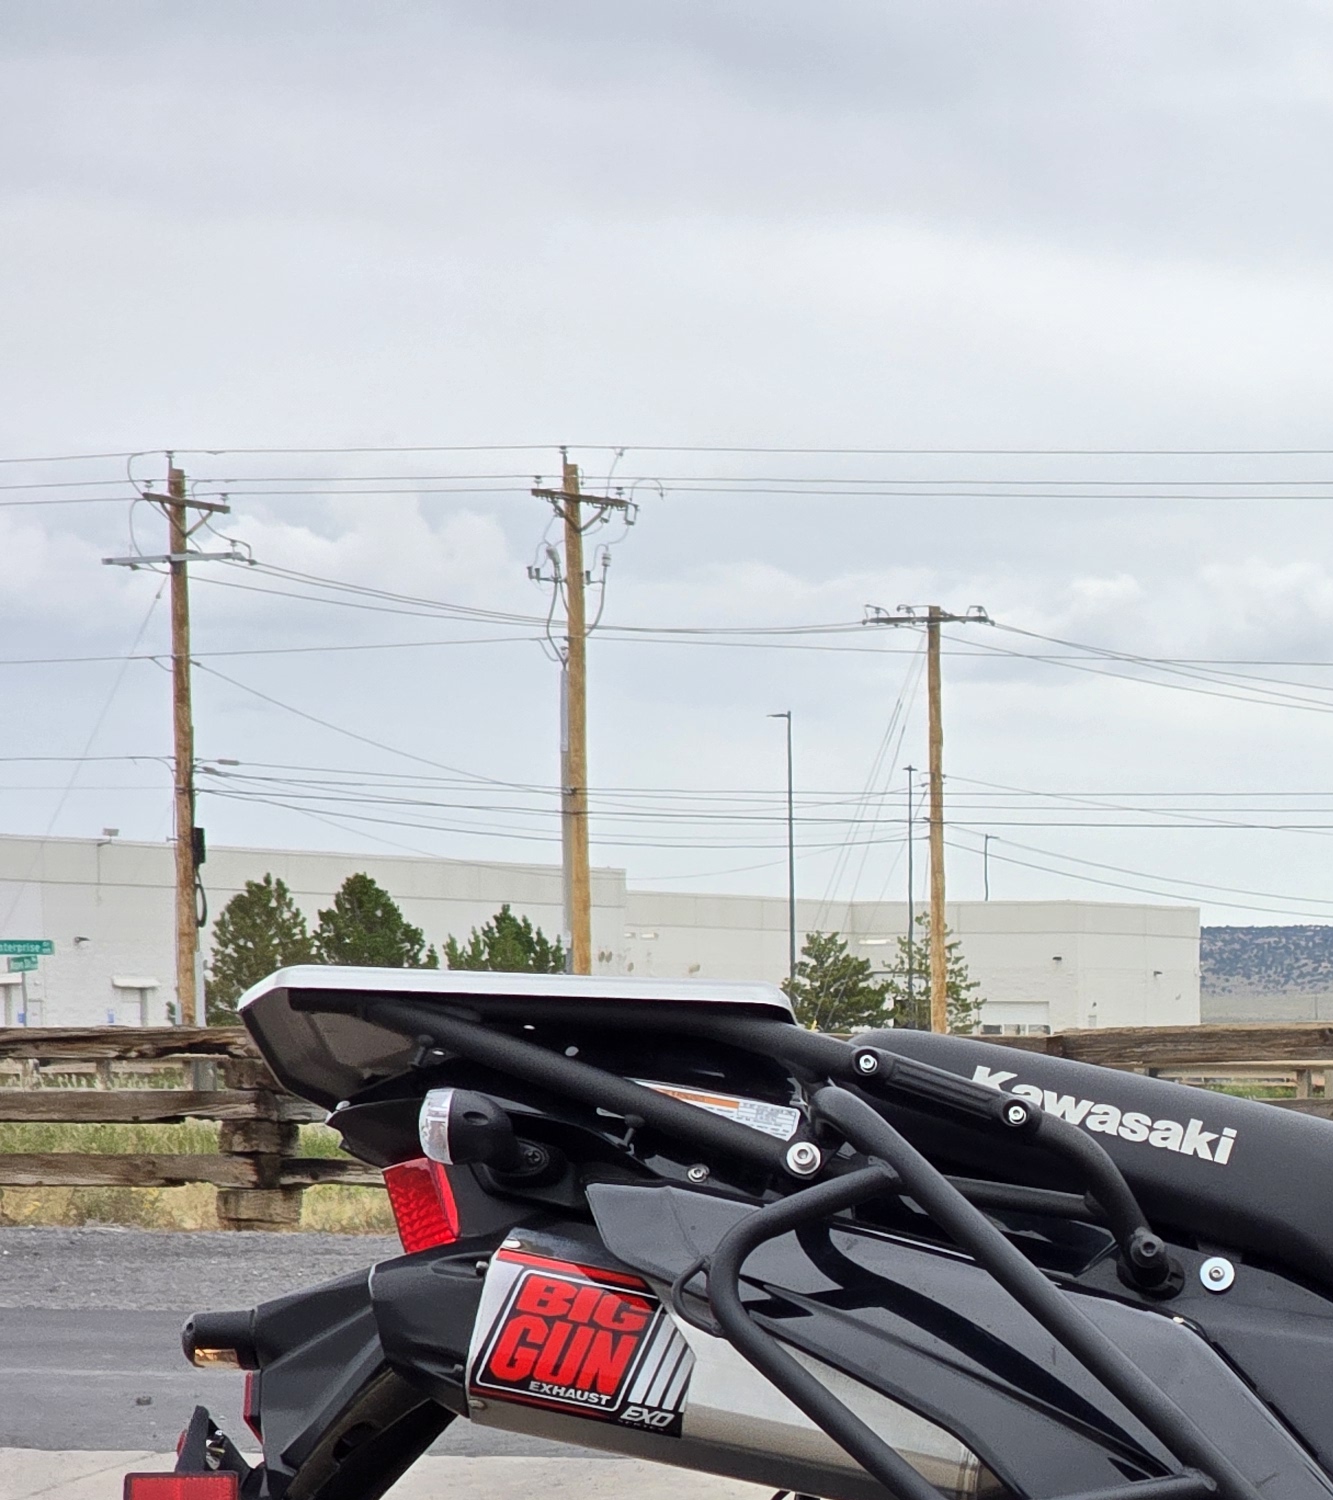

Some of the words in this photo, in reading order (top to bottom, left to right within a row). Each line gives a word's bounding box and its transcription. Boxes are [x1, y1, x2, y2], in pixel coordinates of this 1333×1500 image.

[971, 1065, 1238, 1165] Kawasaki
[516, 1275, 654, 1332] BIG
[489, 1315, 639, 1395] GUN
[529, 1381, 612, 1405] EXHAUST
[620, 1405, 675, 1427] EXO
